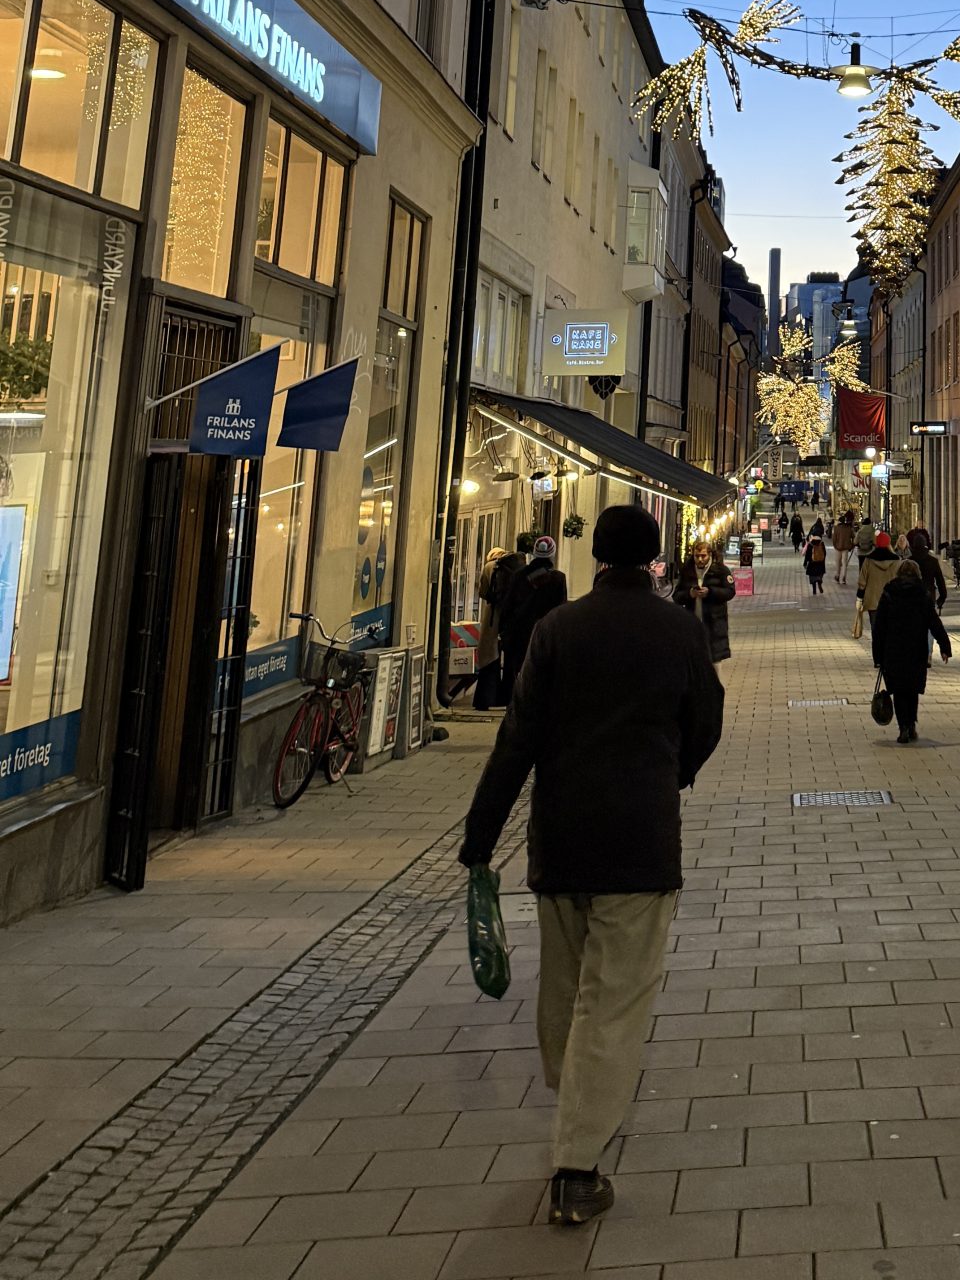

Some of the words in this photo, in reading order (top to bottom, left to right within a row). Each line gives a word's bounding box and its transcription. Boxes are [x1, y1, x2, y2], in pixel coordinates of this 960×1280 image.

[268, 23, 326, 102] FINANS
[206, 416, 256, 429] FRILANS
[207, 428, 251, 441] FINANS
[843, 432, 881, 443] Scandic
[0, 753, 11, 778] et
[14, 742, 52, 773] företag
